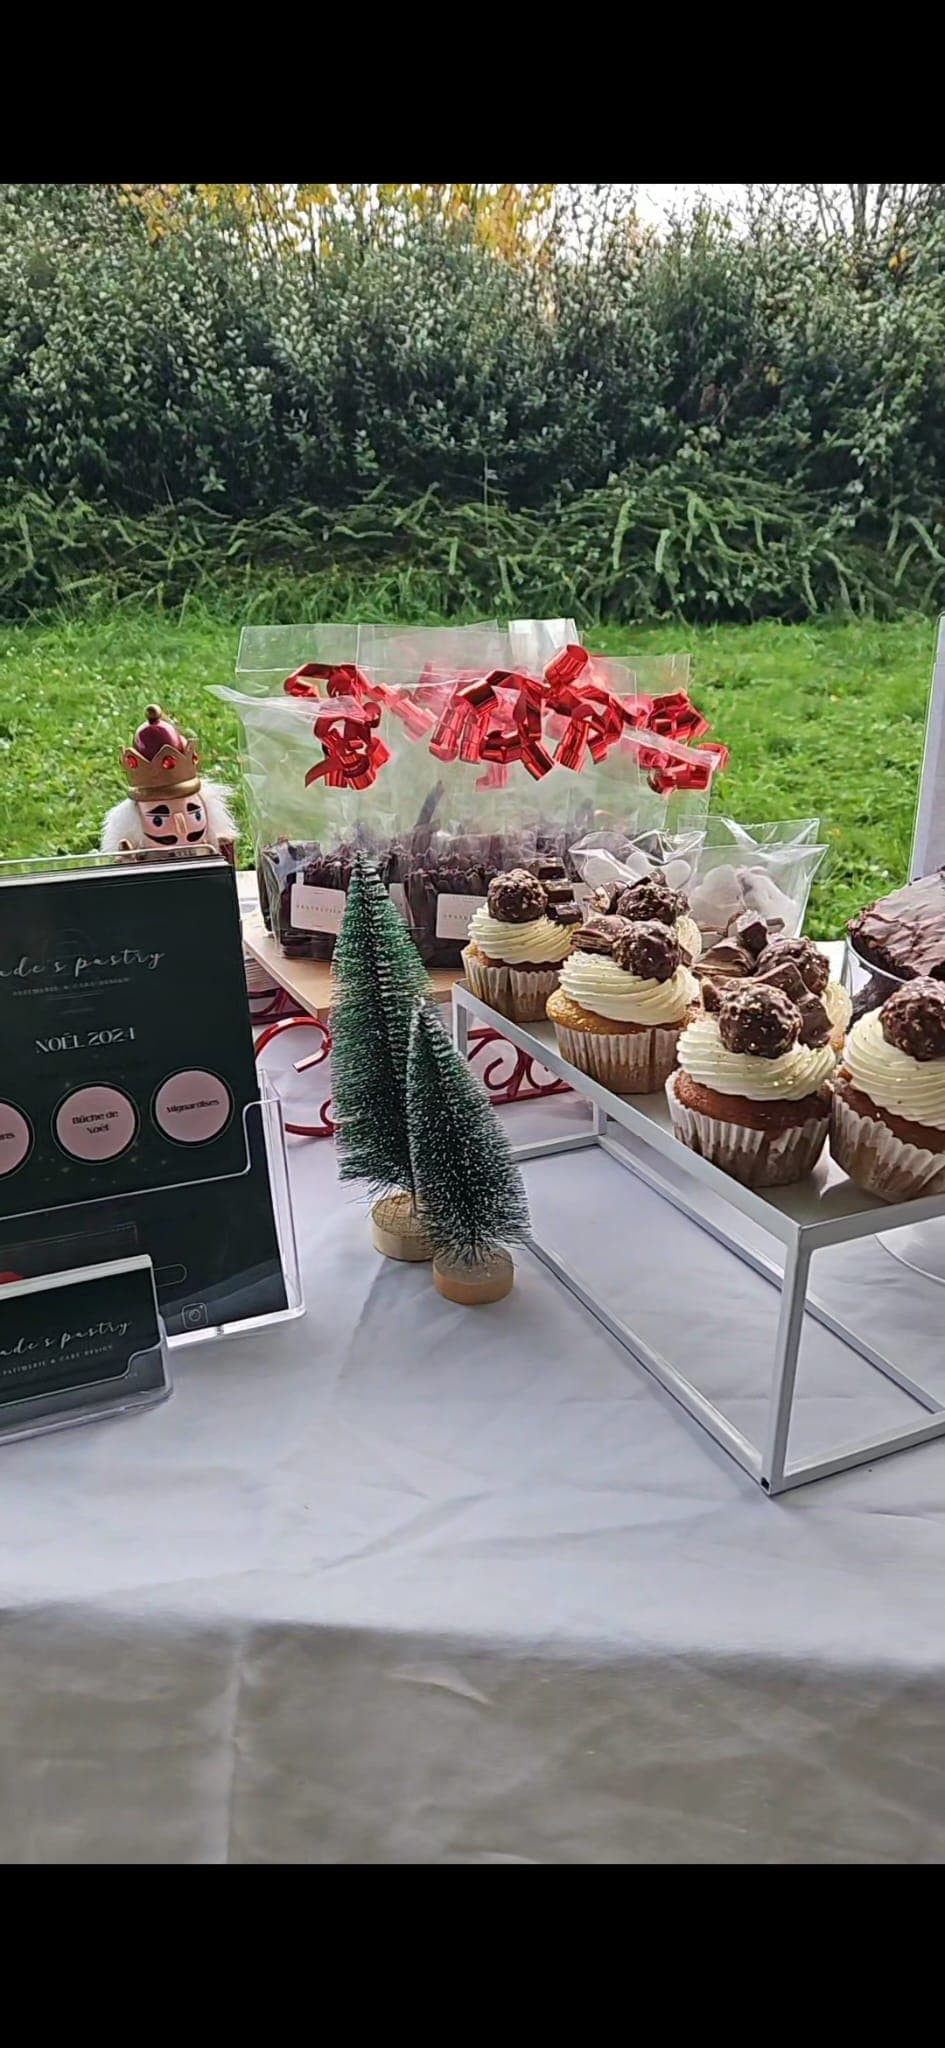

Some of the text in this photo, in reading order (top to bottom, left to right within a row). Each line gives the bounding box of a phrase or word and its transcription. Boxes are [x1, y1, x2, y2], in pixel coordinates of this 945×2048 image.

[74, 949, 165, 977] pastry
[105, 1110, 119, 1120] de
[61, 1320, 133, 1350] pastry
